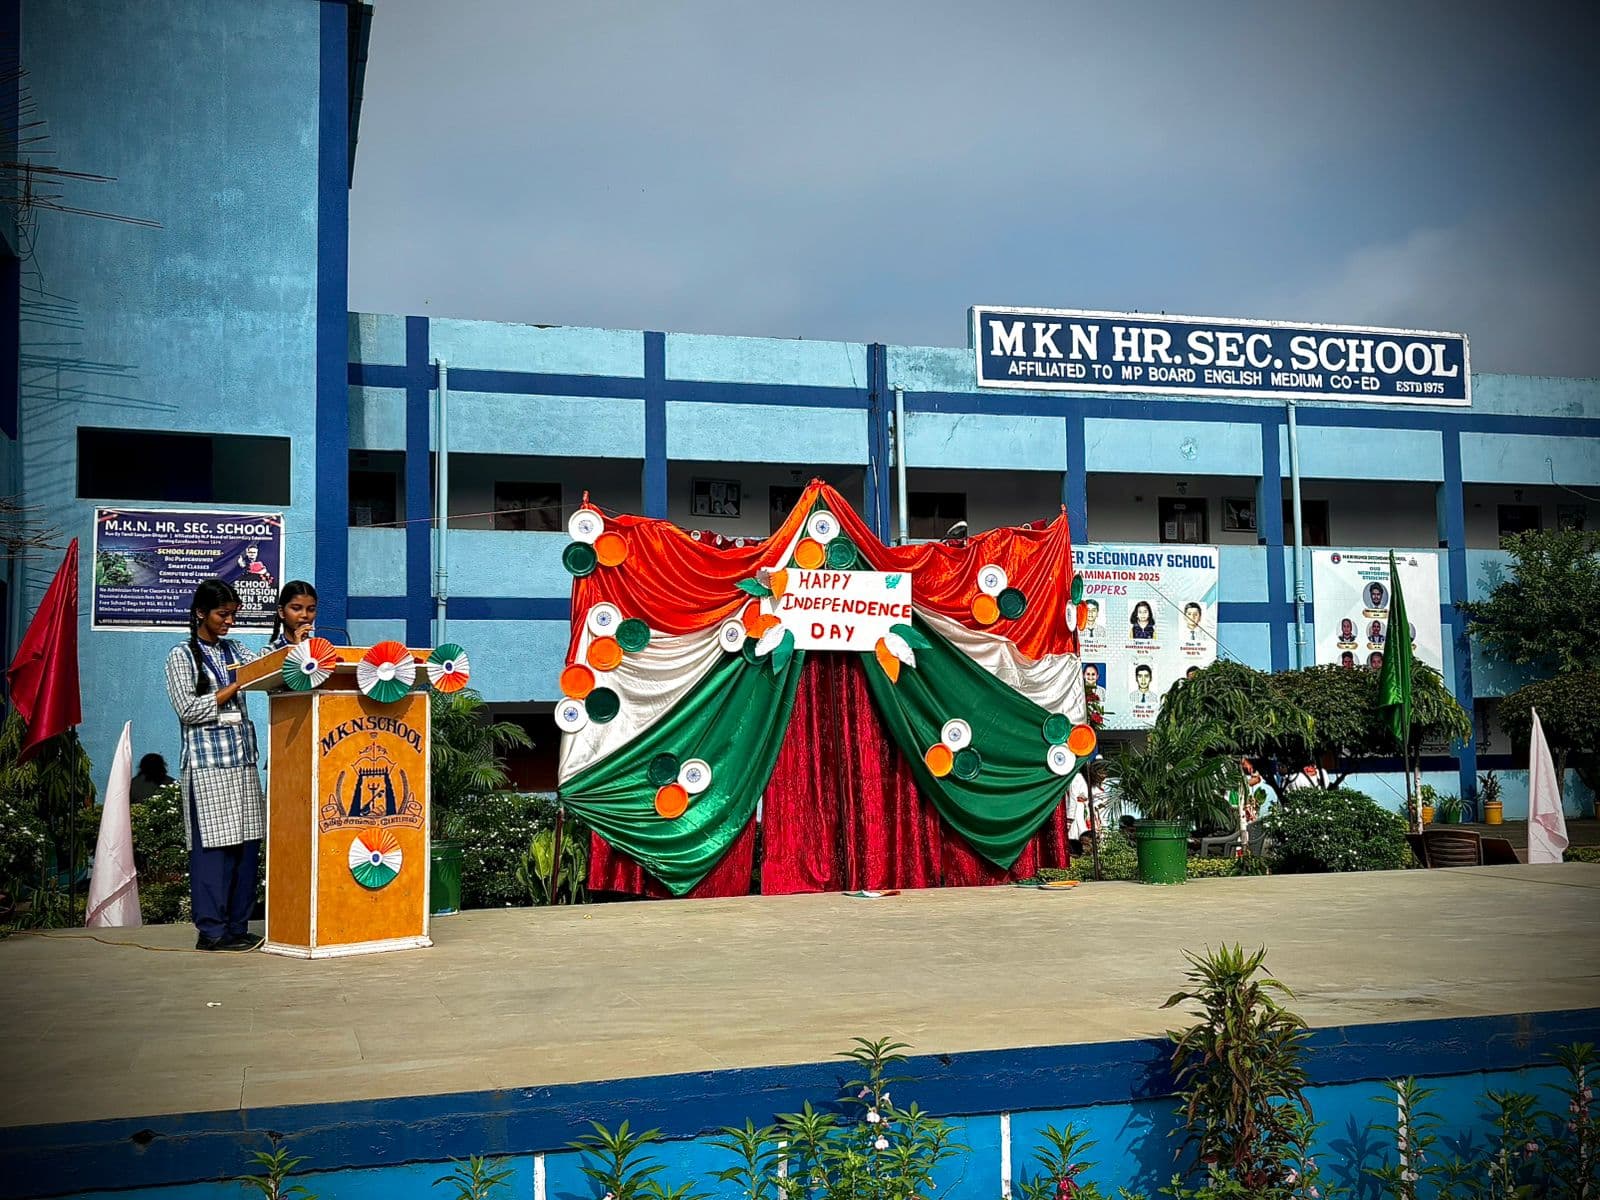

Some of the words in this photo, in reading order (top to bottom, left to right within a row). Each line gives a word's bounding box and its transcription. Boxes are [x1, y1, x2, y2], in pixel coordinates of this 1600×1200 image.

[1290, 335, 1459, 378] SCHOOL
[1008, 360, 1086, 379] AFFILIATED
[1092, 364, 1113, 380] TO
[1121, 365, 1143, 381] MP
[1148, 366, 1196, 383] BOARD
[1204, 369, 1263, 386] ENGLISH
[1271, 372, 1323, 388] MEDIUM
[1330, 374, 1381, 390] CO-ED
[105, 519, 151, 532] M.K.N.
[156, 521, 180, 533] HR.
[183, 523, 213, 534] SEC.
[217, 523, 273, 536] SCHOOL
[1070, 550, 1085, 565] ER
[1087, 551, 1164, 568] SECONDARY
[1167, 556, 1216, 570] SCHOOL
[234, 580, 271, 589] SCHOOL
[799, 571, 852, 591] HAPPY
[1138, 572, 1161, 582] 2025
[257, 596, 275, 604] FOR
[1084, 584, 1128, 596] OPPERS
[241, 603, 263, 611] 2025
[782, 593, 912, 619] INDEPENDENCE
[810, 622, 855, 643] DAY
[366, 715, 423, 754] SCHOOL
